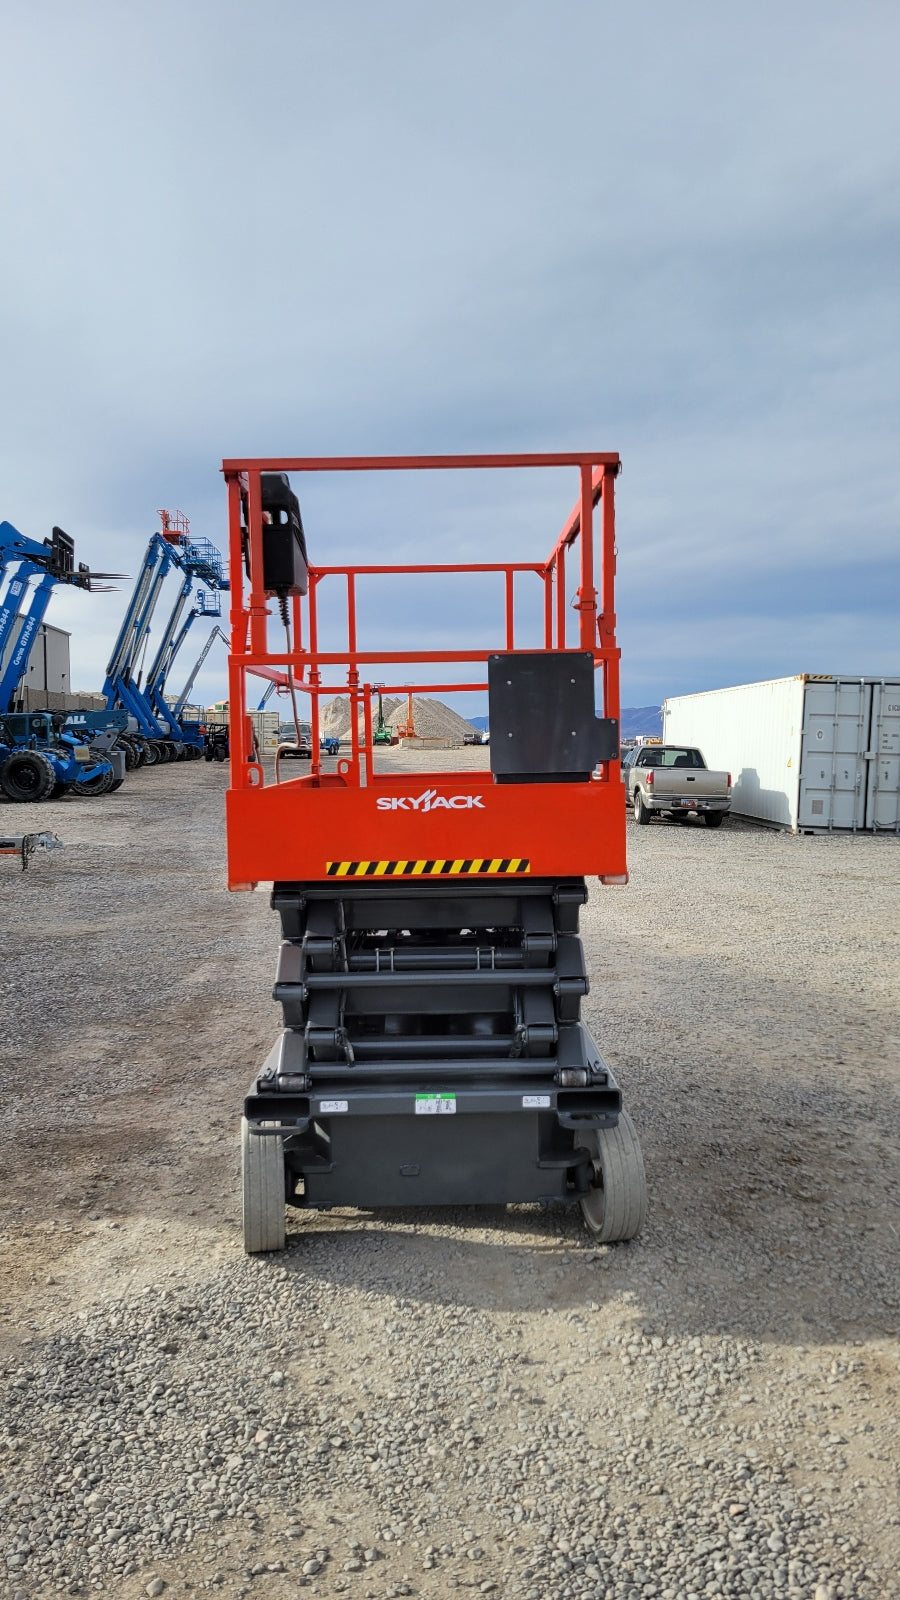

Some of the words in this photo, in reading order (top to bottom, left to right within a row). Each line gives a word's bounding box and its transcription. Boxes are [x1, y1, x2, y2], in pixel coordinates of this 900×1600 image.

[13, 648, 25, 666] Genie
[20, 616, 36, 647] GTH-844
[376, 789, 486, 813] SKYJACK
